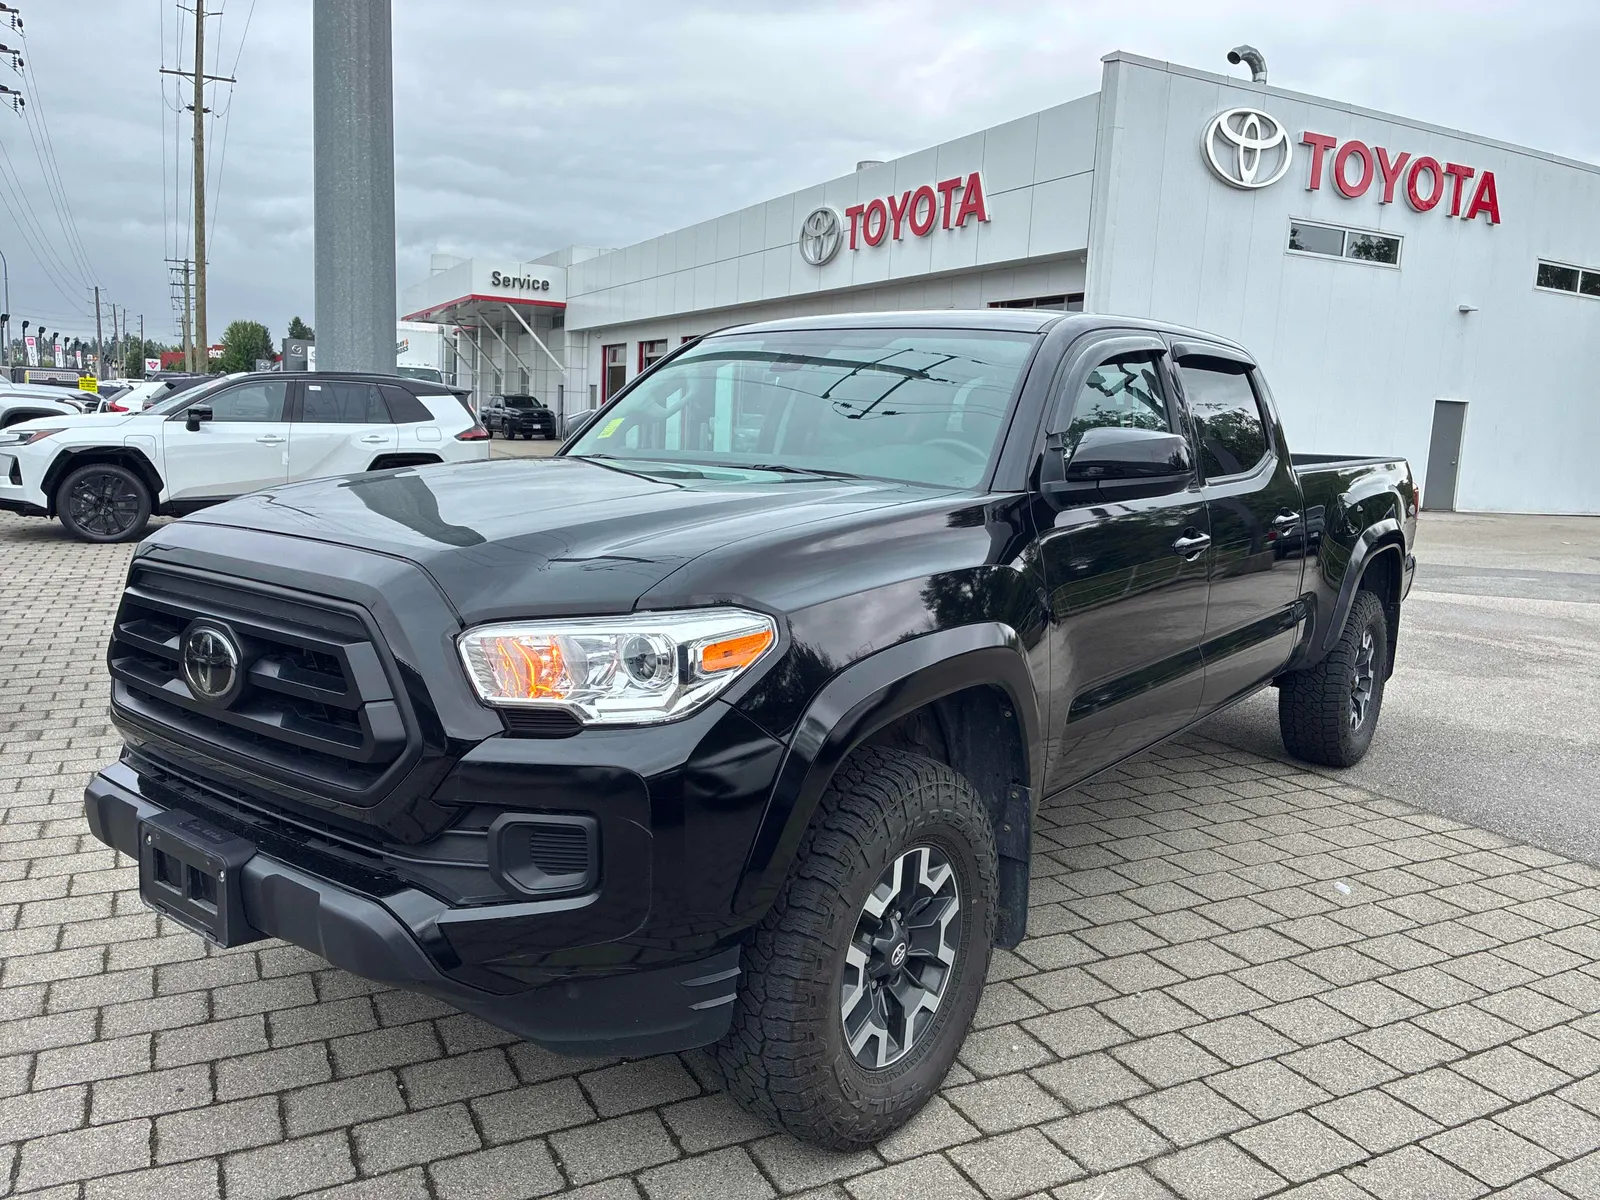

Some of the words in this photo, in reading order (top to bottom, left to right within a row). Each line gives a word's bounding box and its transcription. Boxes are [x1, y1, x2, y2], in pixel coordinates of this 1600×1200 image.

[845, 171, 991, 251] TOYOTA
[1298, 131, 1501, 225] TOYOTA
[491, 271, 550, 291] Service
